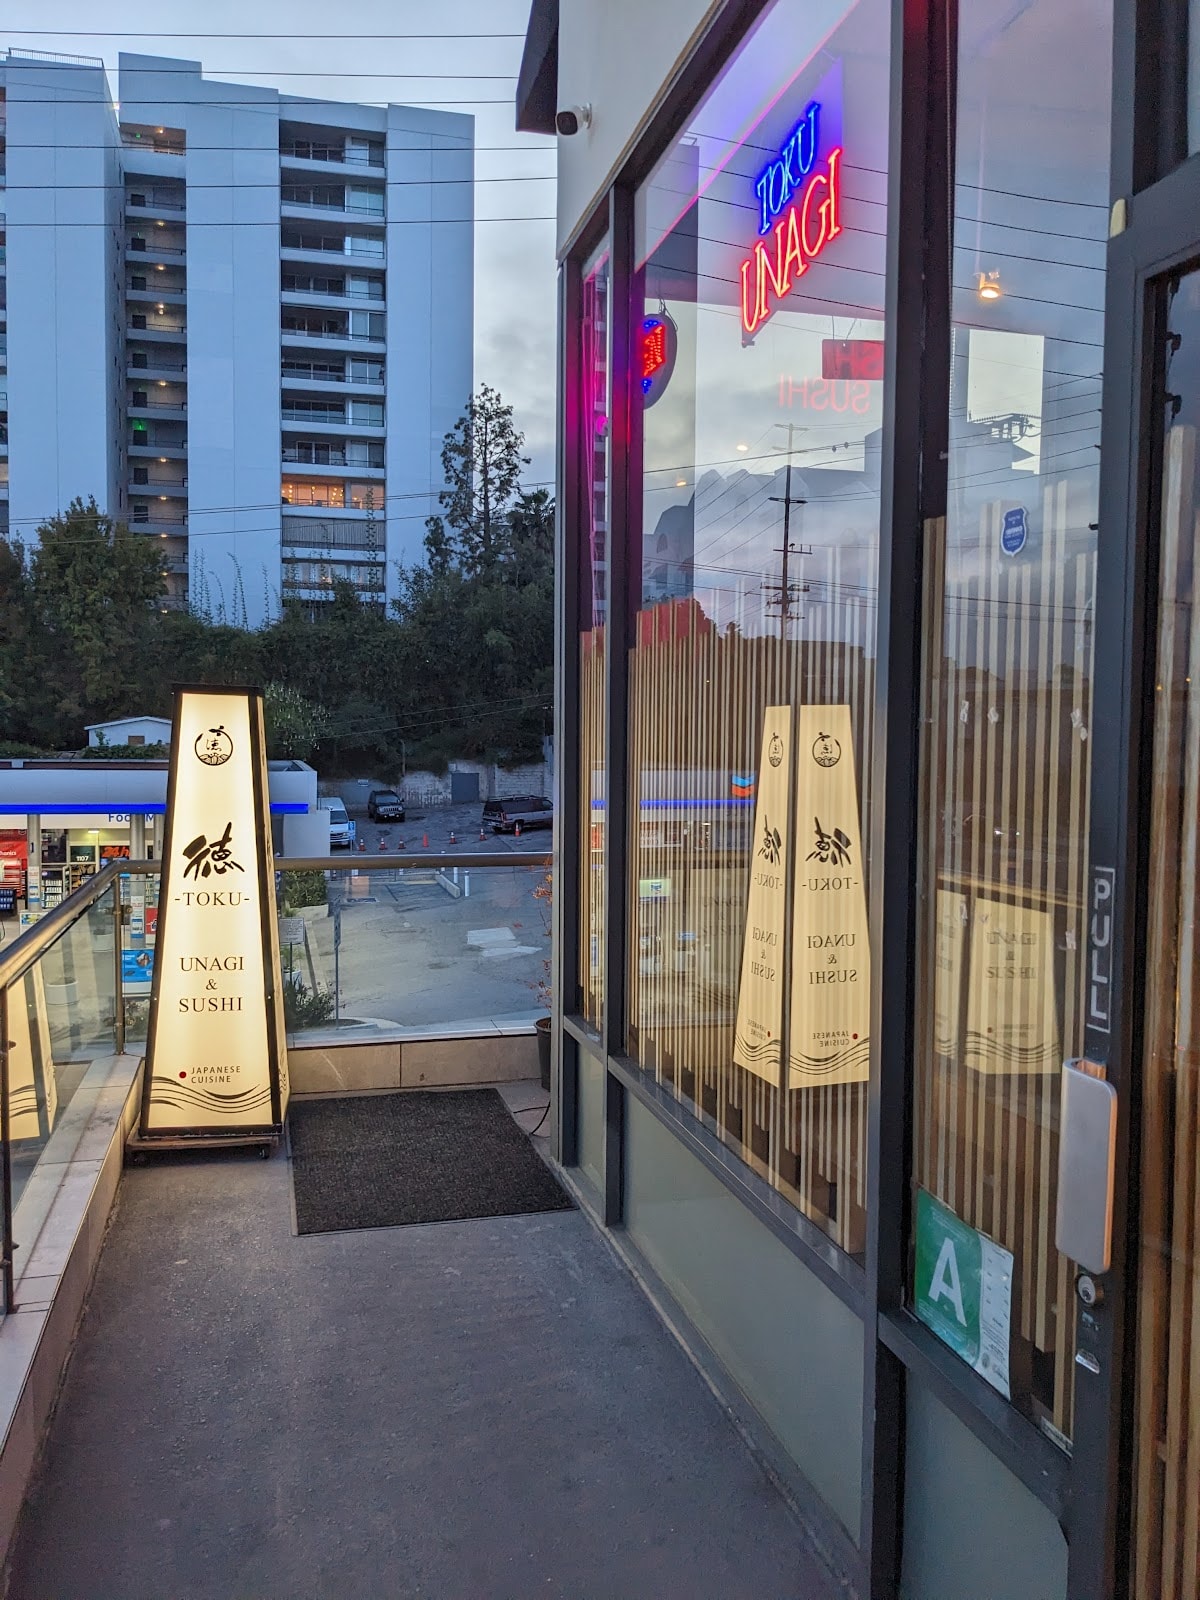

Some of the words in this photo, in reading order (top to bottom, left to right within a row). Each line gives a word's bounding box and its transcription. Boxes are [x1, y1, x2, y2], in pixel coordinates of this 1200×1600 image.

[756, 101, 820, 234] TOKU
[740, 147, 841, 332] UNAGI
[108, 813, 131, 822] Foo
[1090, 878, 1111, 1020] PULL
[179, 956, 245, 972] UNAGI
[205, 978, 218, 991] &
[179, 996, 243, 1013] SUSHI
[191, 1065, 242, 1075] JAPANESE
[191, 1075, 232, 1085] CUISINE
[927, 1236, 968, 1328] A
